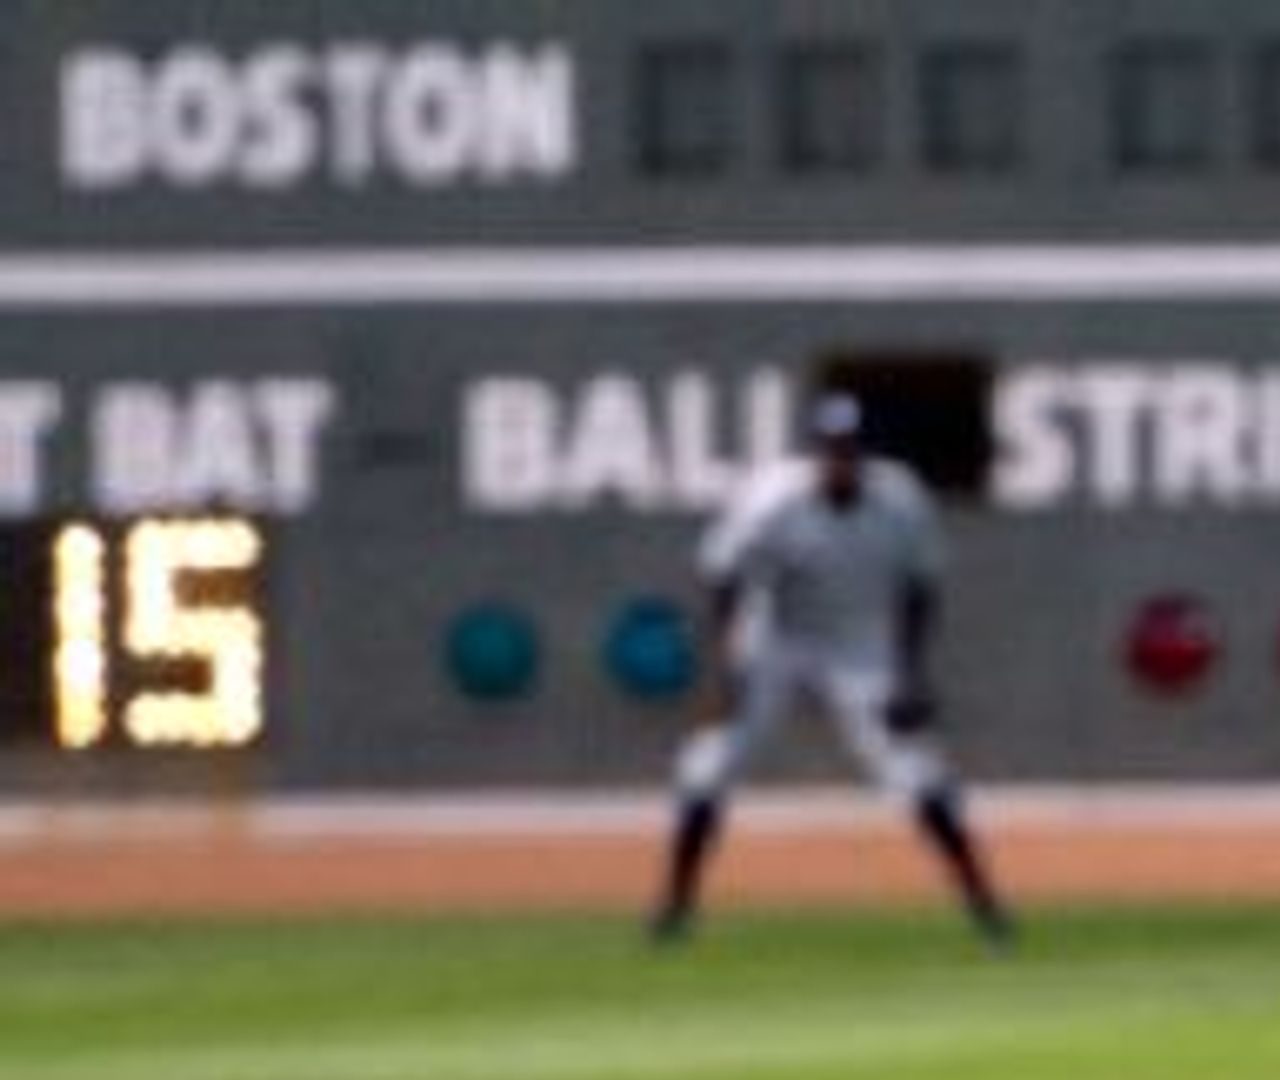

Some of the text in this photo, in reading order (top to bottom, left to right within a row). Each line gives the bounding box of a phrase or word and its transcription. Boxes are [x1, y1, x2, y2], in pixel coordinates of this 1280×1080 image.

[60, 46, 575, 185] BOSTON
[93, 379, 332, 513] BAT
[54, 520, 262, 746] 15
